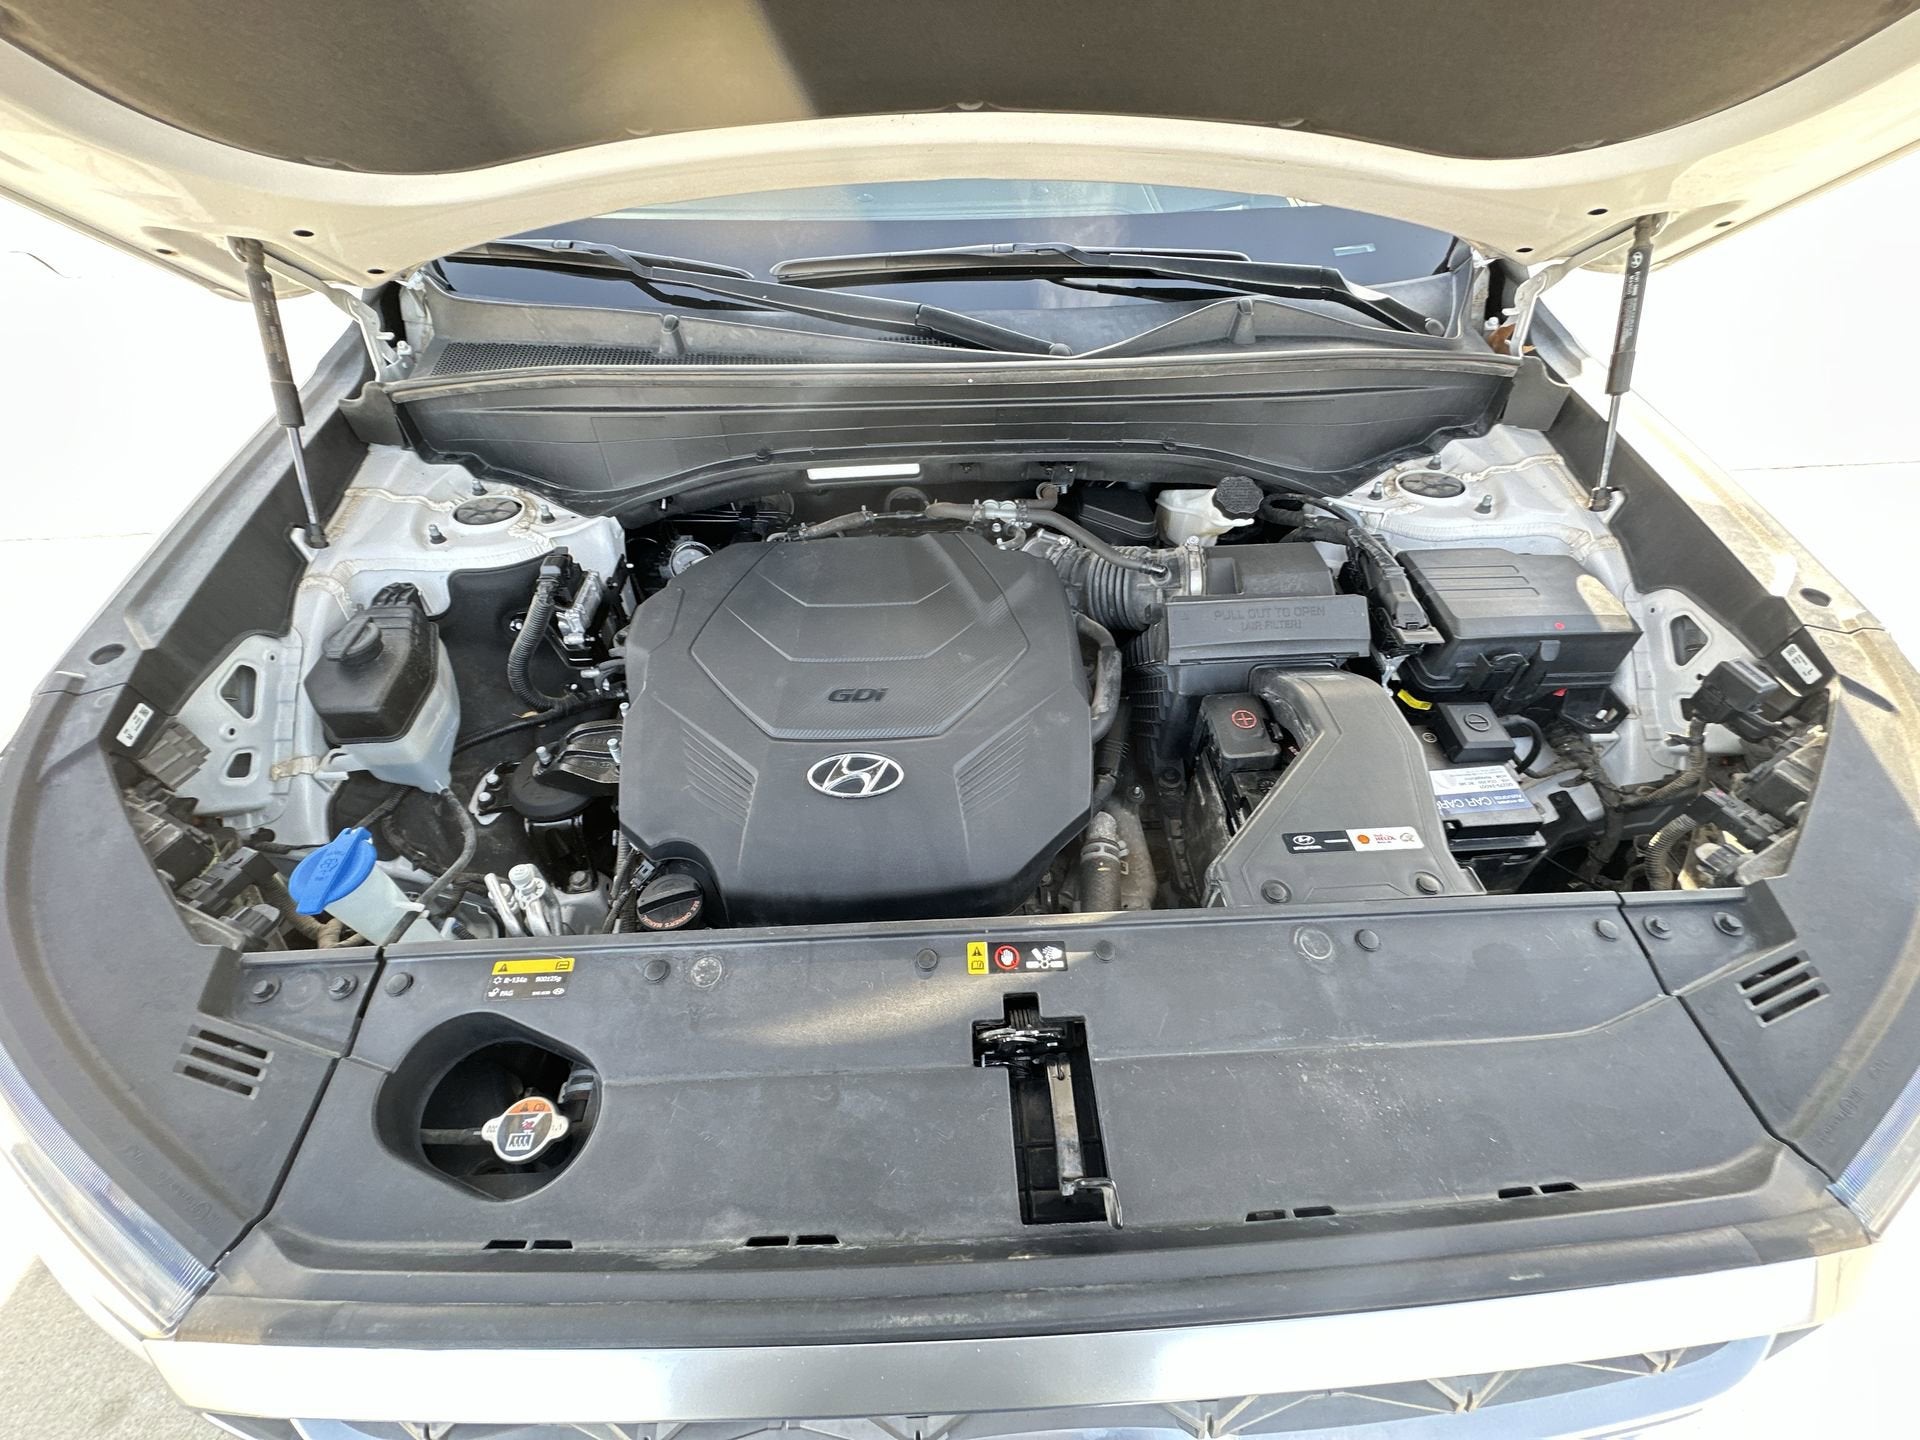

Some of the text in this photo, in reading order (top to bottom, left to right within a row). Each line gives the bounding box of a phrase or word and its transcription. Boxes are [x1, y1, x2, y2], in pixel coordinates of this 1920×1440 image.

[1214, 606, 1326, 620] PULL OUT TO OPEN
[828, 688, 889, 703] GDi
[1468, 796, 1492, 806] CAR
